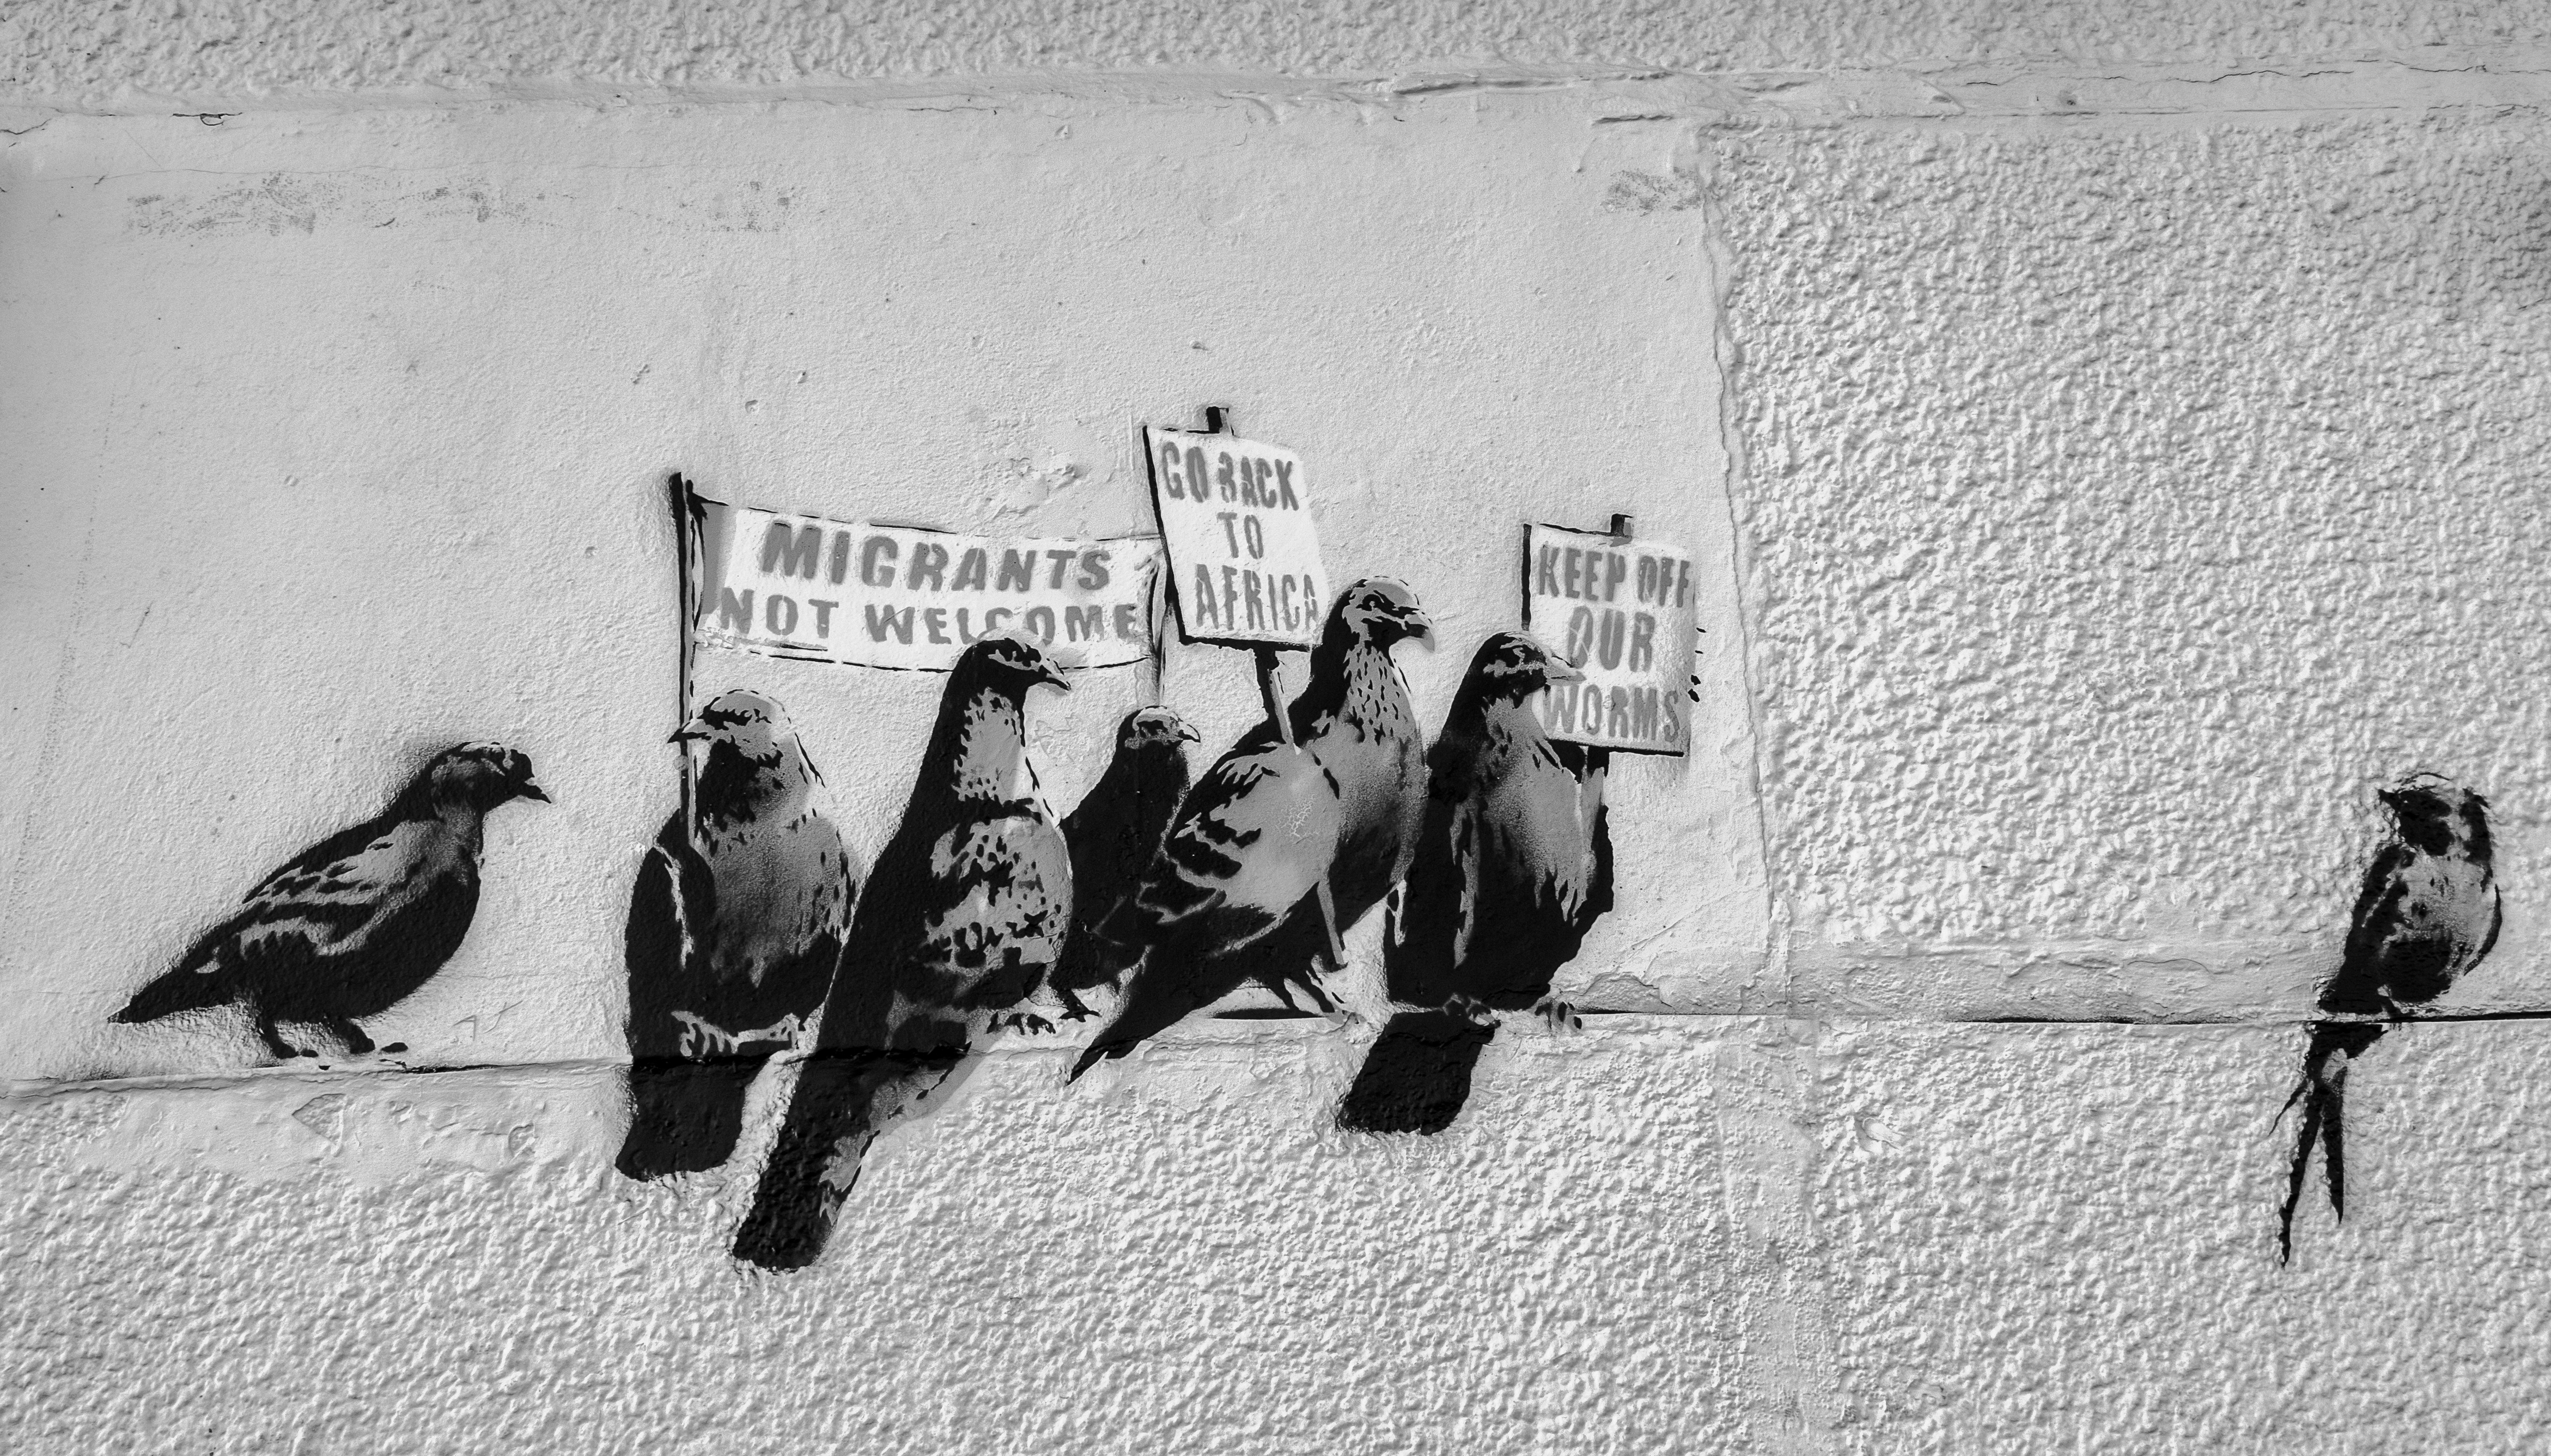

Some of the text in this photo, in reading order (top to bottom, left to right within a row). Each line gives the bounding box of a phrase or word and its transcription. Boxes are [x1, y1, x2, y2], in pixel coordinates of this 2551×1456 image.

[1162, 442, 1299, 510] GO BACK
[760, 520, 1111, 592] MIGRANTS
[1217, 512, 1264, 559] TO
[1195, 564, 1319, 631] AFRICA
[1538, 546, 1691, 607] KEEP OFF
[720, 587, 1136, 645] NOT WELCOME
[1567, 605, 1656, 672] OUR
[1543, 684, 1680, 742] WORMS
